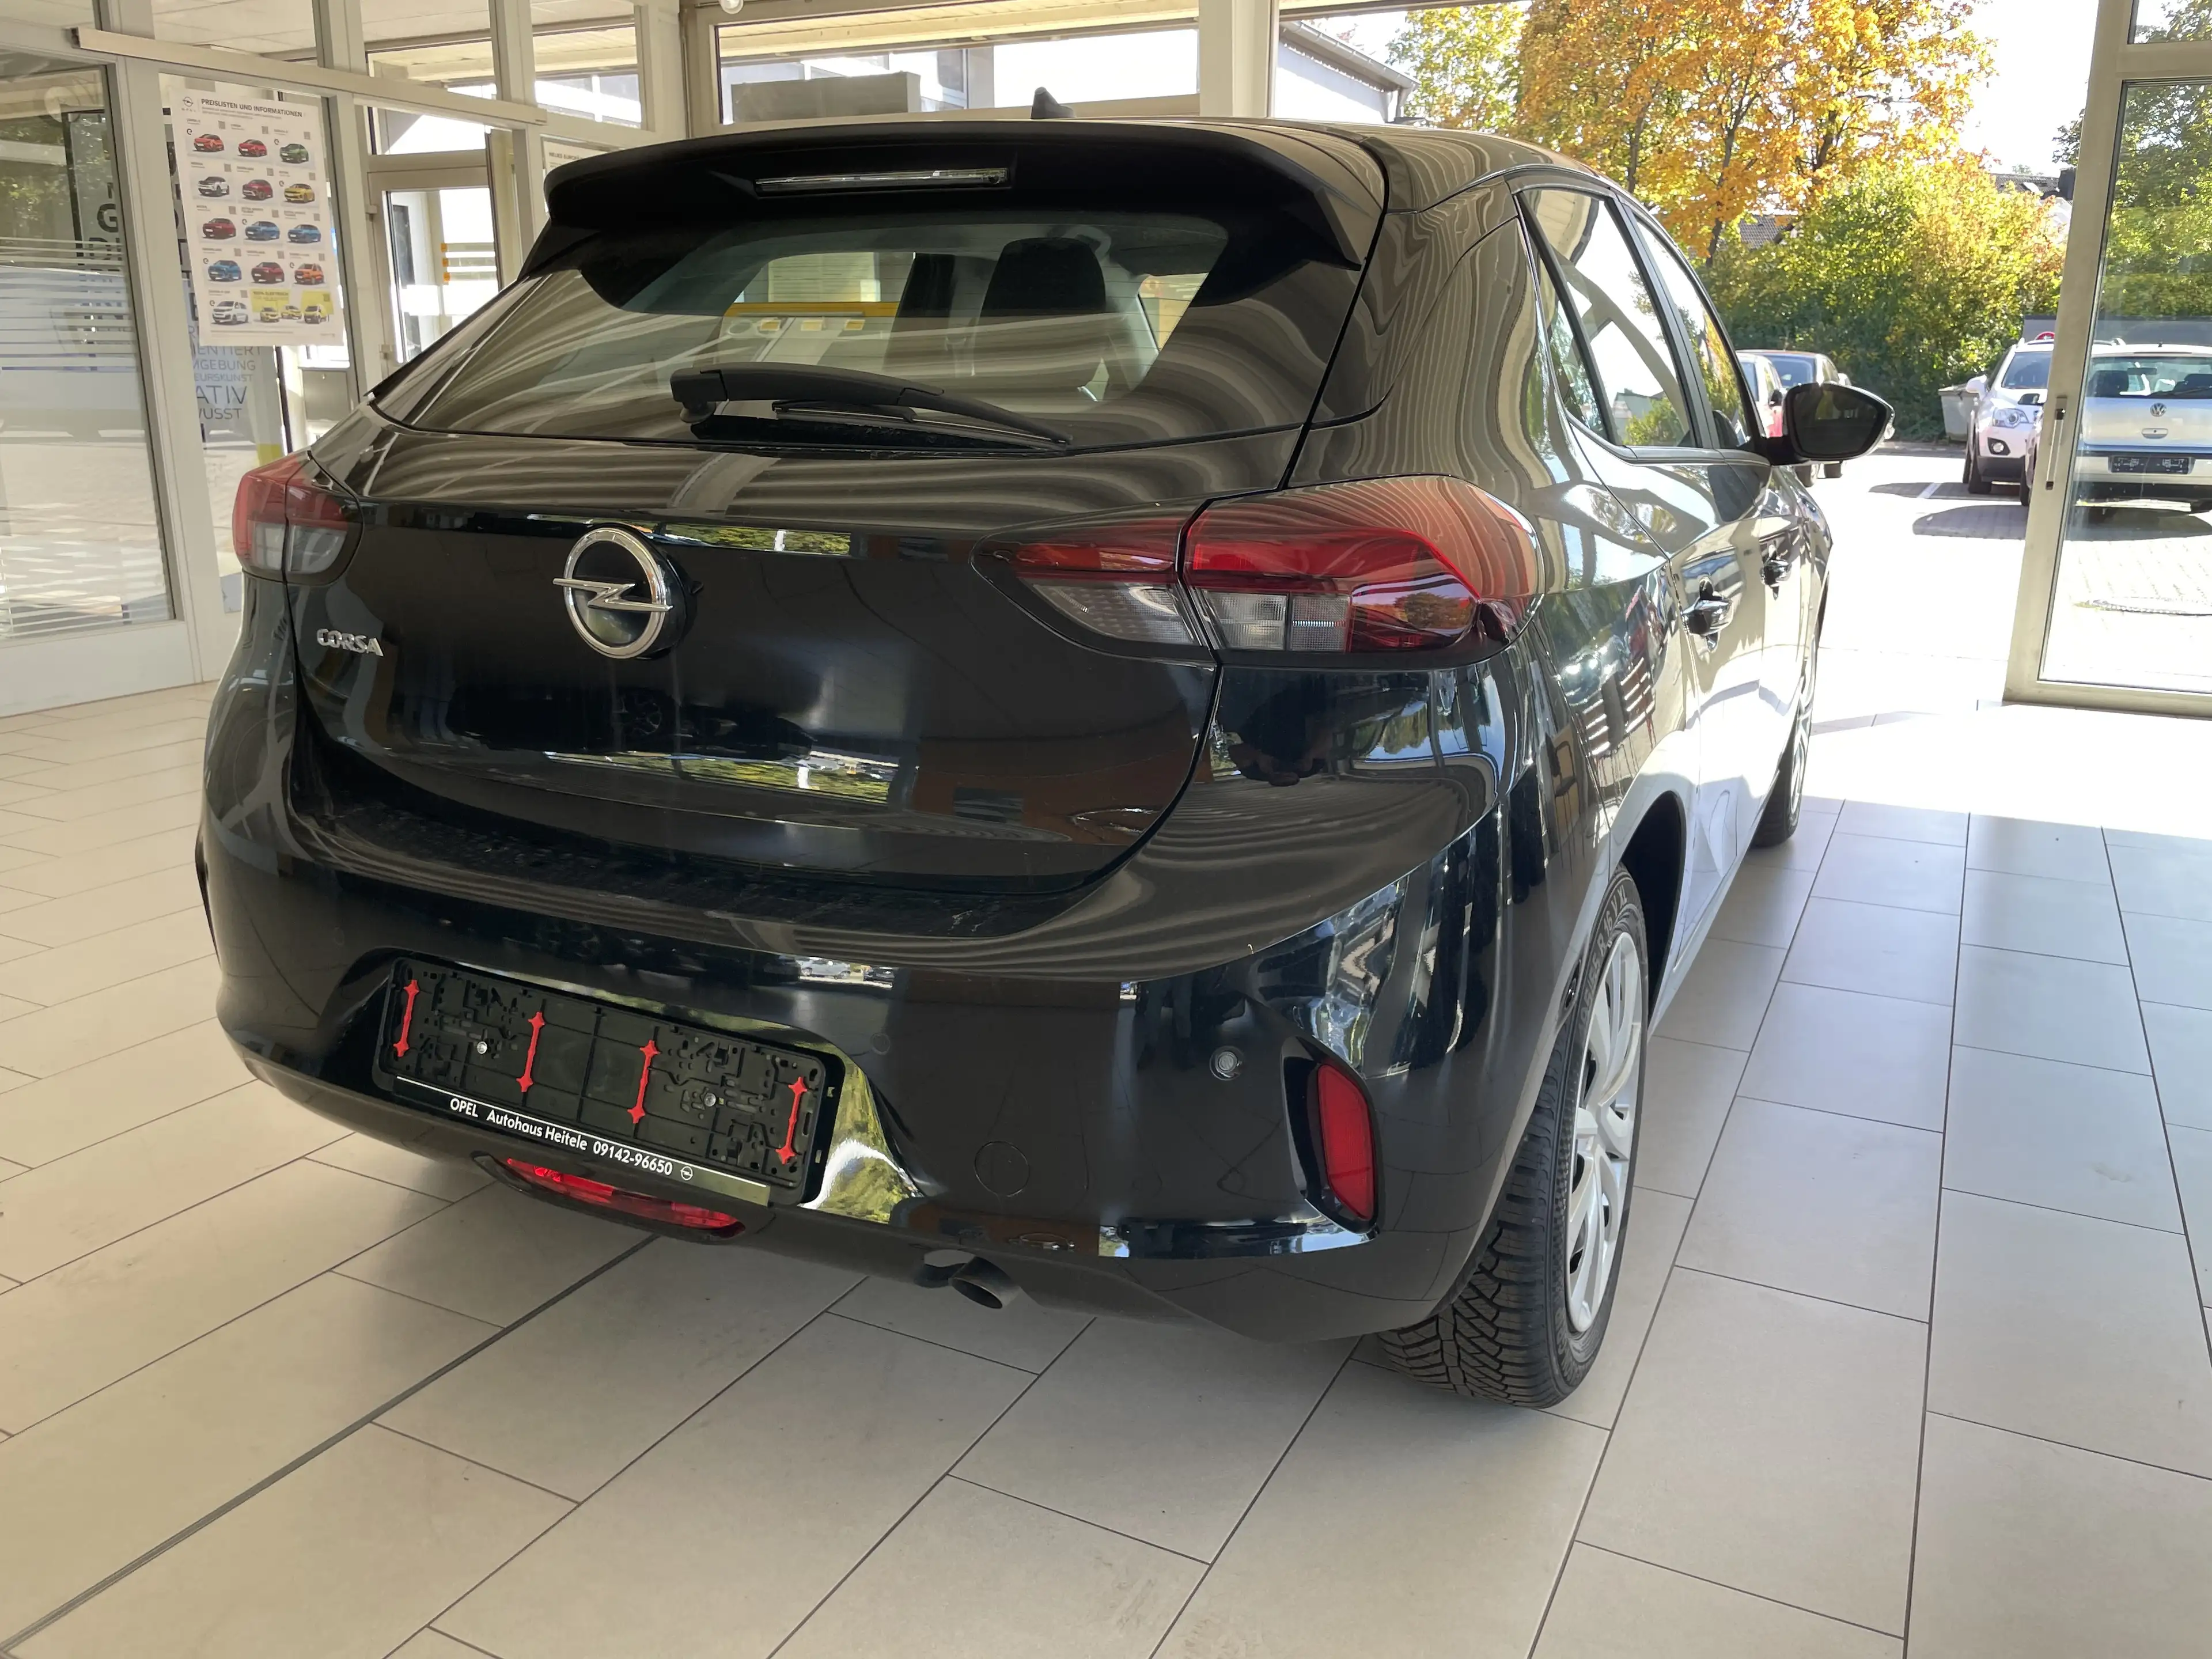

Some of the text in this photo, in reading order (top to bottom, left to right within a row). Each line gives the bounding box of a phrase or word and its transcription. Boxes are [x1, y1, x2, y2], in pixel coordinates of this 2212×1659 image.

[201, 99, 238, 109] PREISLISTEN
[253, 106, 302, 117] INFORMATIONEN
[317, 628, 384, 657] CORSA
[1597, 933, 1608, 957] R
[1603, 911, 1613, 938] 16
[1617, 884, 1627, 909] XL
[450, 1098, 673, 1176] OPEL Autohaus Heitele 09142-96650
